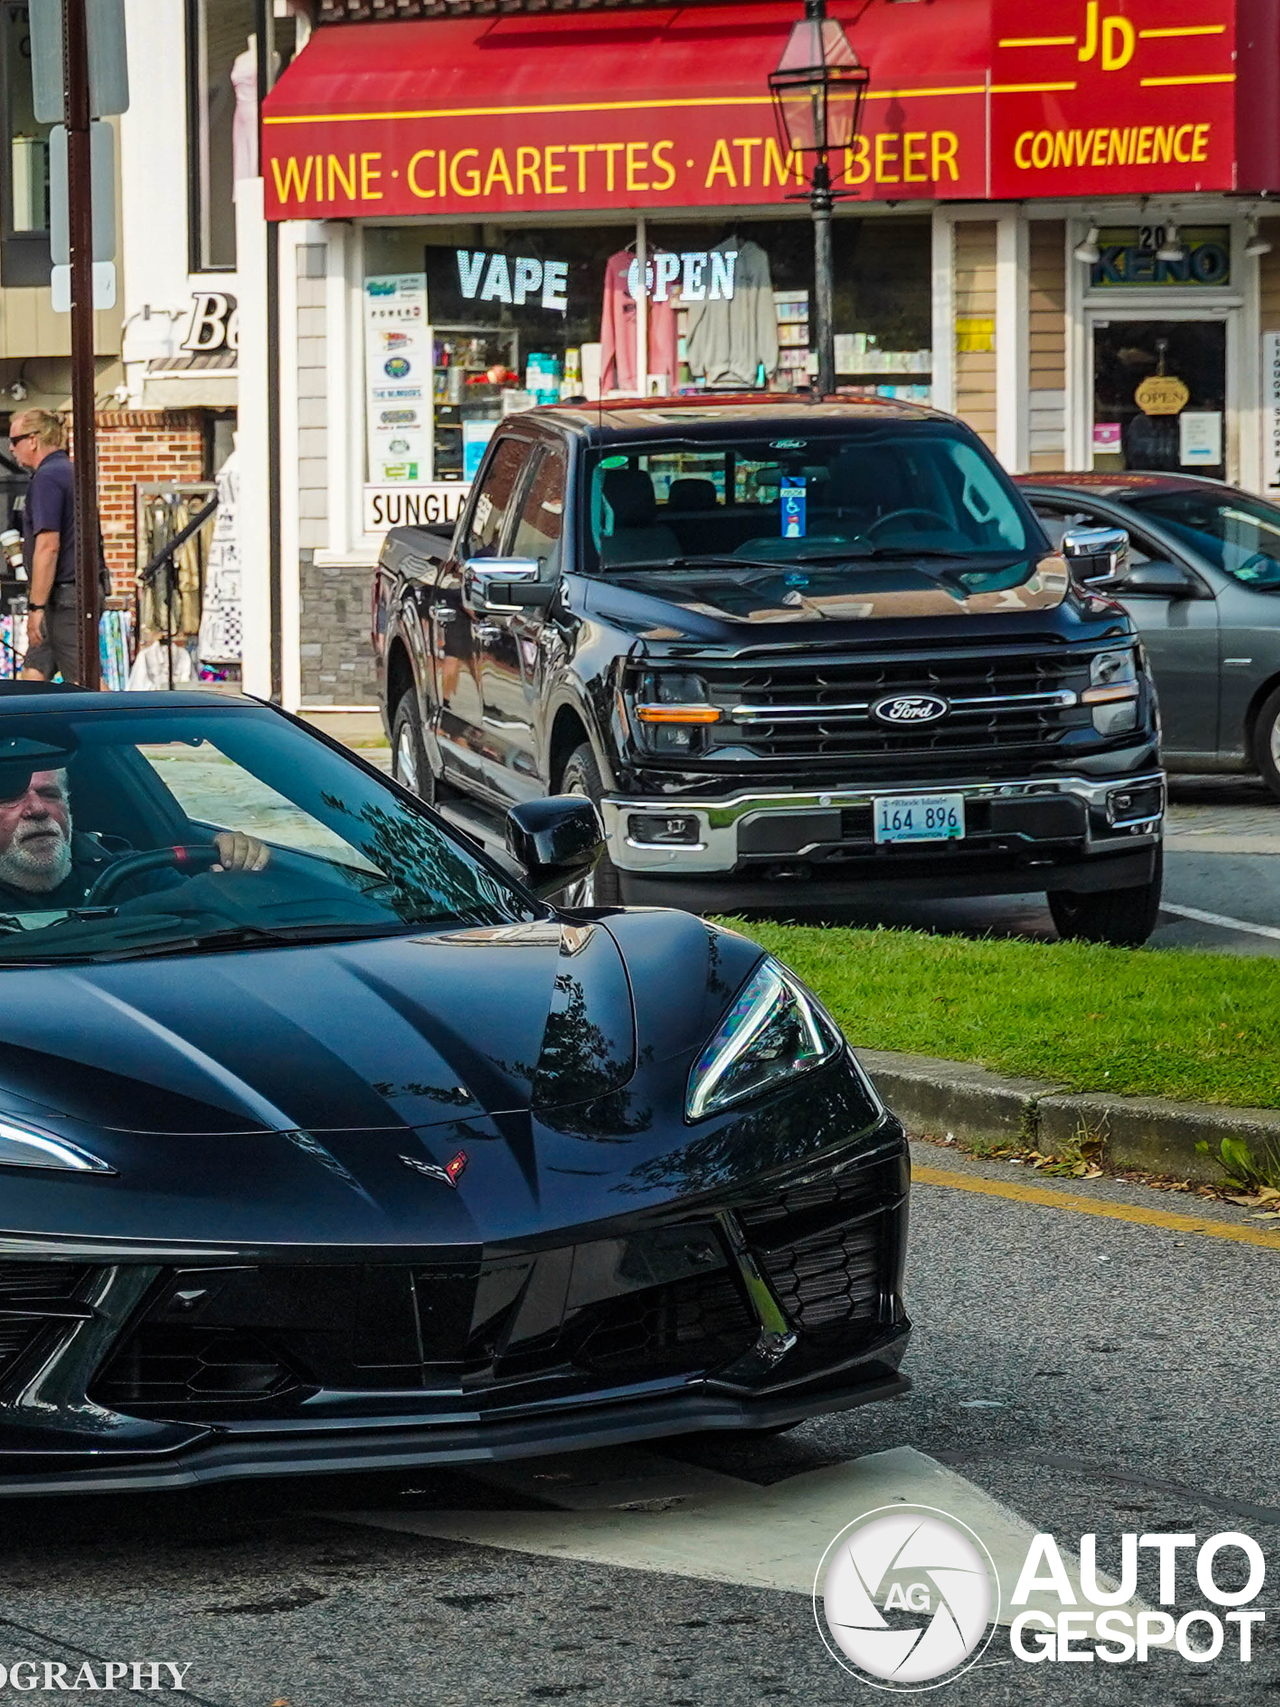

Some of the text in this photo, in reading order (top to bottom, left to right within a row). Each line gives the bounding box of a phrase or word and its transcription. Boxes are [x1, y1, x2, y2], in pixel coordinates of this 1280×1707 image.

[1077, 0, 1136, 71] JD
[270, 130, 959, 204] WINE CIGARETTES ATM BEER
[1014, 123, 1211, 170] CONVENIENCE
[1140, 226, 1166, 250] 20
[456, 249, 569, 312] VAPE
[627, 251, 738, 303] OPEN
[1091, 243, 1230, 283] KENO
[1140, 391, 1184, 404] OPEN
[889, 700, 934, 719] Ford
[881, 807, 957, 831] 164 896
